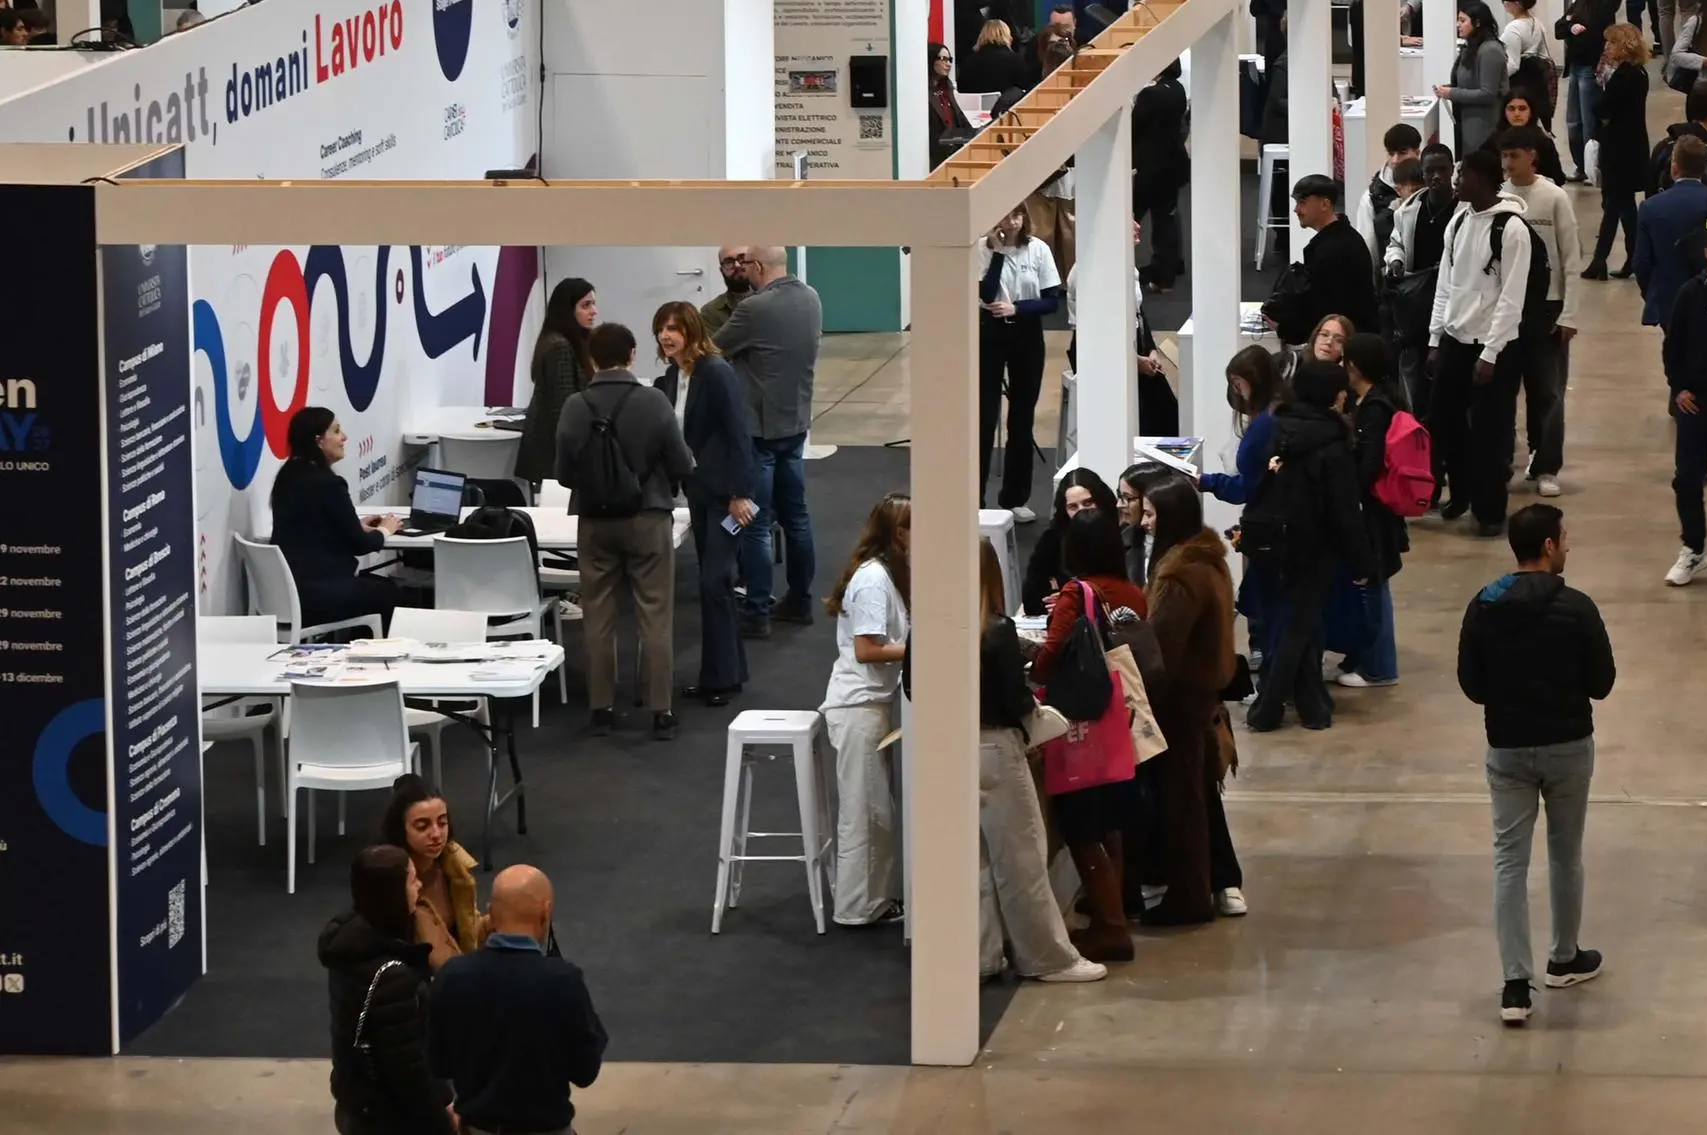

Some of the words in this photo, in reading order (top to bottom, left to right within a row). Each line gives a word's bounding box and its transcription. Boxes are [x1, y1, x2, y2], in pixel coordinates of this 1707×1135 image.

[226, 30, 309, 124] domani
[16, 462, 50, 470] UNICO
[10, 544, 61, 554] novembre
[10, 577, 62, 586] novembre
[10, 609, 62, 618] novembre
[11, 640, 62, 651] novembre
[2, 672, 14, 682] 13
[16, 672, 64, 683] dicembre
